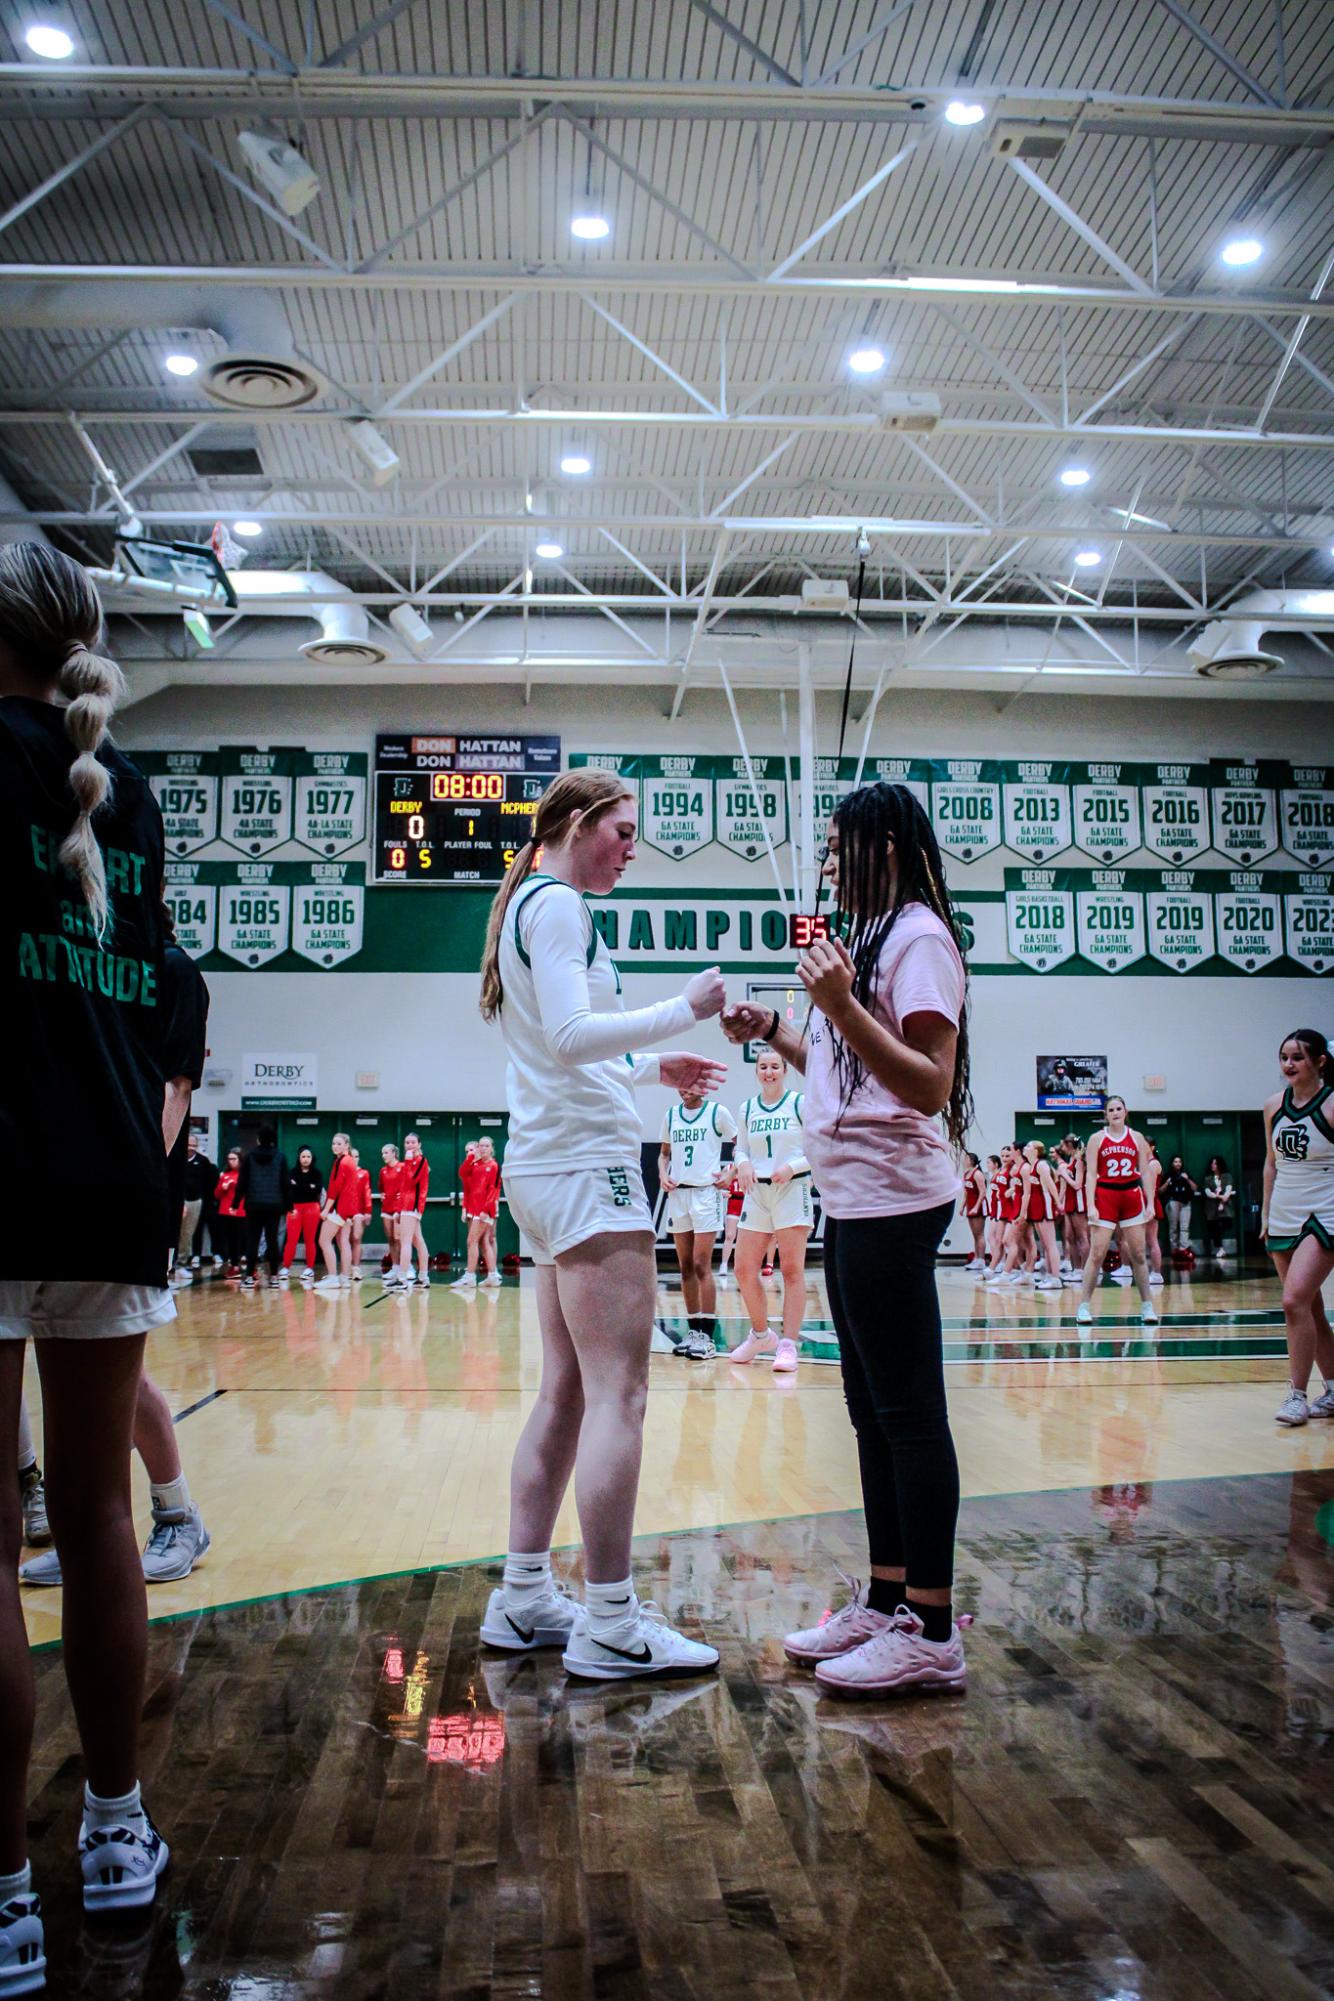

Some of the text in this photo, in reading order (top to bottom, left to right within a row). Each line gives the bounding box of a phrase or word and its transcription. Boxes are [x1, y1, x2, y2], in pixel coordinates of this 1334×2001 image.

[417, 740, 450, 752] DON
[460, 741, 521, 752] HATTAN
[240, 755, 276, 767] DERBY
[314, 755, 349, 768] DERBY
[417, 755, 522, 768] DON HATTAN
[660, 758, 696, 770] DERBY
[876, 760, 911, 774] DERBY
[948, 761, 982, 775] DERBY
[1018, 763, 1052, 776] DERBY
[1088, 764, 1121, 777] DERBY
[1158, 766, 1190, 779] DERBY
[1226, 768, 1259, 780] DERBY
[1294, 769, 1326, 782] DERBY
[434, 775, 502, 798] 08:00
[161, 789, 207, 814] 1975
[233, 789, 282, 814] 1976
[306, 790, 354, 814] 1977
[390, 801, 422, 813] DERBY
[653, 793, 703, 816] 1994
[454, 808, 480, 816] PERIOD
[939, 796, 993, 820] 2008
[1014, 798, 1060, 821] 2013
[1083, 799, 1129, 822] 2015
[1152, 800, 1200, 824] 2016
[1221, 801, 1266, 825] 2017
[1288, 803, 1334, 826] 2018
[252, 819, 273, 828] STATE
[332, 819, 352, 829] STATE
[408, 815, 424, 839] 0
[673, 822, 695, 830] STATE
[962, 825, 982, 834] STATE
[233, 829, 278, 839] CHAMPIONS
[308, 830, 352, 839] CHAMPIONS
[656, 832, 700, 841] CHAMPIONS
[1033, 826, 1053, 835] STATE
[1102, 828, 1122, 836] STATE
[1172, 829, 1192, 837] STATE
[1241, 830, 1260, 839] STATE
[1309, 831, 1328, 840] STATE
[729, 833, 773, 841] CHAMPIOS
[945, 835, 988, 844] CHAMPIONS
[1016, 836, 1059, 845] CHAMPIONS
[1086, 838, 1128, 846] CHAMPIONS
[1156, 838, 1198, 847] CHAMPIONS
[384, 840, 407, 848] FOULS
[444, 841, 472, 849] PLAYER
[474, 841, 492, 849] FOUL
[1225, 840, 1267, 849] CHAMPIONS
[391, 849, 405, 868] 0
[164, 864, 199, 877] DERBY
[237, 864, 274, 878] DERBY
[311, 864, 347, 878] DERBY
[383, 870, 480, 879] SCORE MATCH
[1022, 870, 1056, 883] DERBY
[1092, 871, 1126, 884] DERBY
[1162, 872, 1195, 884] DERBY
[1230, 873, 1263, 885] DERBY
[1300, 874, 1331, 886] DERBY
[230, 900, 280, 924] 1985
[303, 900, 355, 924] 1986
[1015, 905, 1064, 929] 2018
[1087, 906, 1134, 929] 2019
[1156, 906, 1203, 930] 2019
[1223, 907, 1273, 931] 2020
[176, 929, 197, 938] STATE
[250, 930, 271, 939] STATE
[323, 930, 345, 939] STATE
[796, 917, 827, 944] 35
[231, 940, 276, 949] CHAMPIONS
[305, 940, 350, 949] CHAMPIONS
[1036, 934, 1056, 943] STATE
[1107, 935, 1127, 943] STATE
[1176, 935, 1196, 944] STATE
[1245, 936, 1265, 944] STATE
[1314, 937, 1333, 946] STATE
[1020, 945, 1062, 953] CHAMPIONS
[1090, 945, 1132, 954] CHAMPIONS
[1160, 945, 1202, 954] CHAMPIONS
[1229, 946, 1271, 955] CHAMPIONS
[1298, 946, 1334, 956] CHAMPION
[255, 1064, 304, 1080] DERBY
[751, 1118, 790, 1133] DERBY
[673, 1128, 707, 1143] DERBY
[766, 1135, 772, 1158] 1
[684, 1146, 694, 1167] 3
[1106, 1158, 1133, 1177] 22
